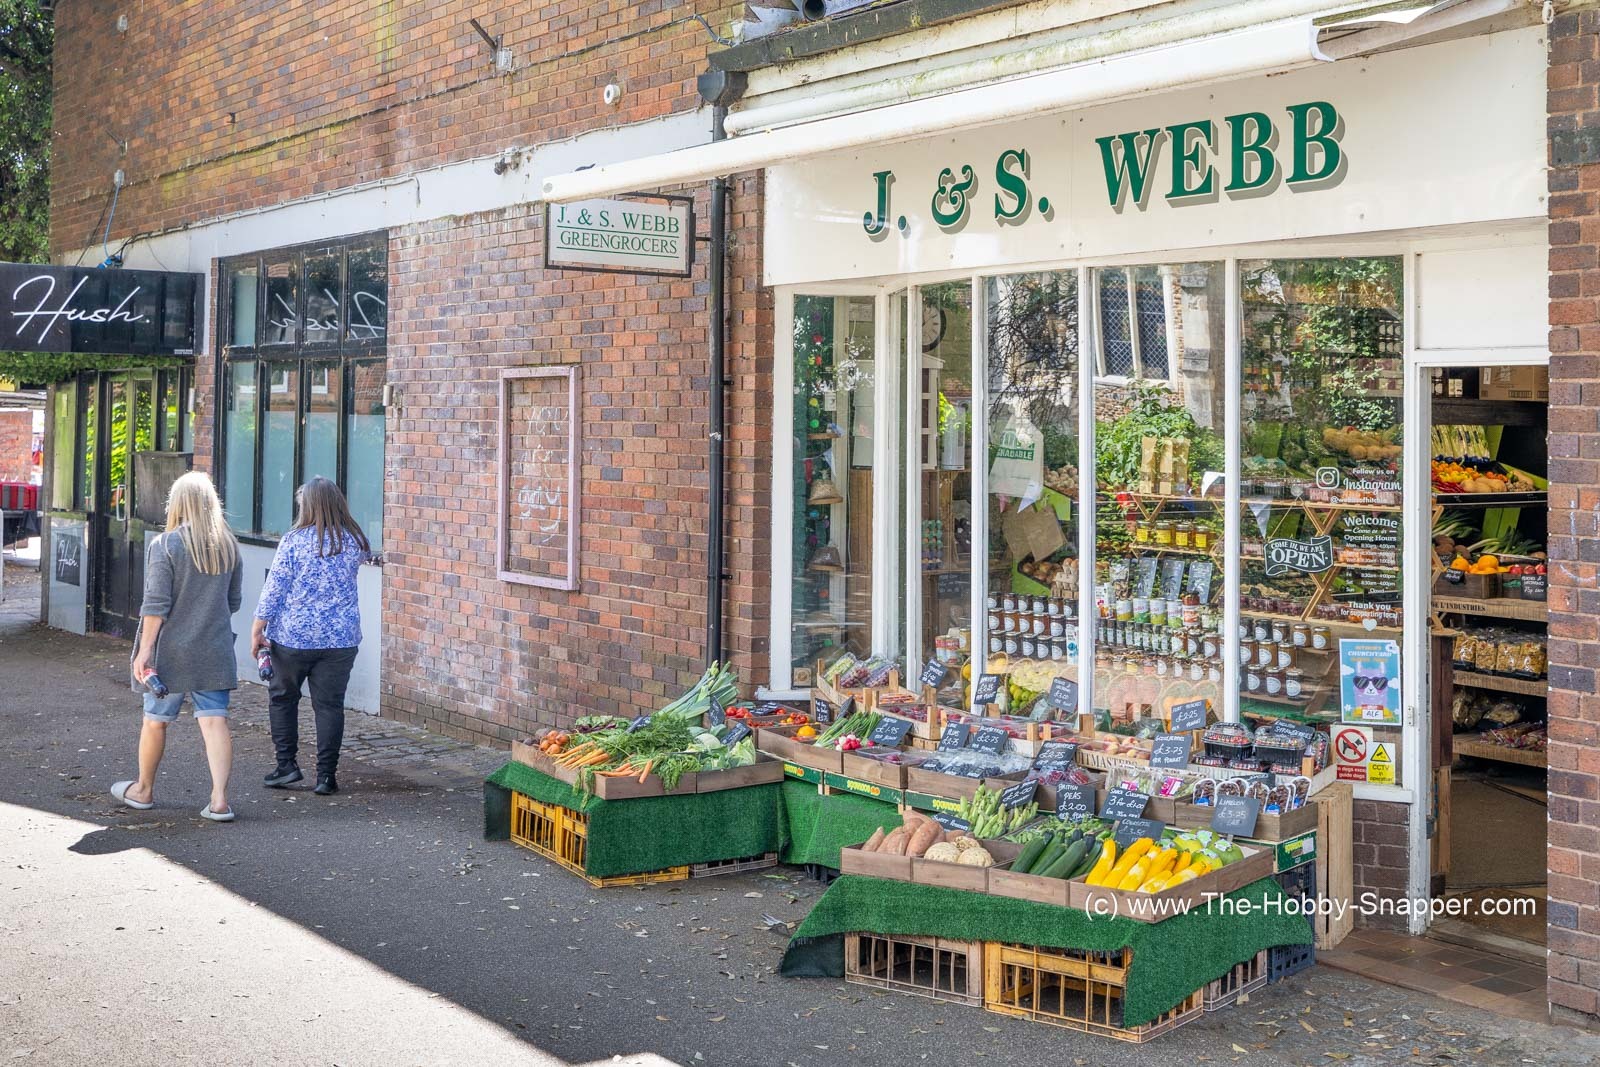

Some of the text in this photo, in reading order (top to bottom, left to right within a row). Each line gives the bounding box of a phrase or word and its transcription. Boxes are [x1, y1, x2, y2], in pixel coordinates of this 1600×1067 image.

[864, 101, 1348, 242] J. & S. WEBB
[557, 206, 680, 234] J. & S. WEBB
[560, 230, 678, 254] GREENGROCERS
[1343, 478, 1402, 495] Instagram
[1344, 515, 1398, 529] Welcome
[1270, 541, 1288, 549] COME
[1271, 548, 1326, 568] OPEN
[1347, 601, 1374, 609] Thank
[1063, 792, 1082, 800] PEAS
[1109, 796, 1116, 806] 3
